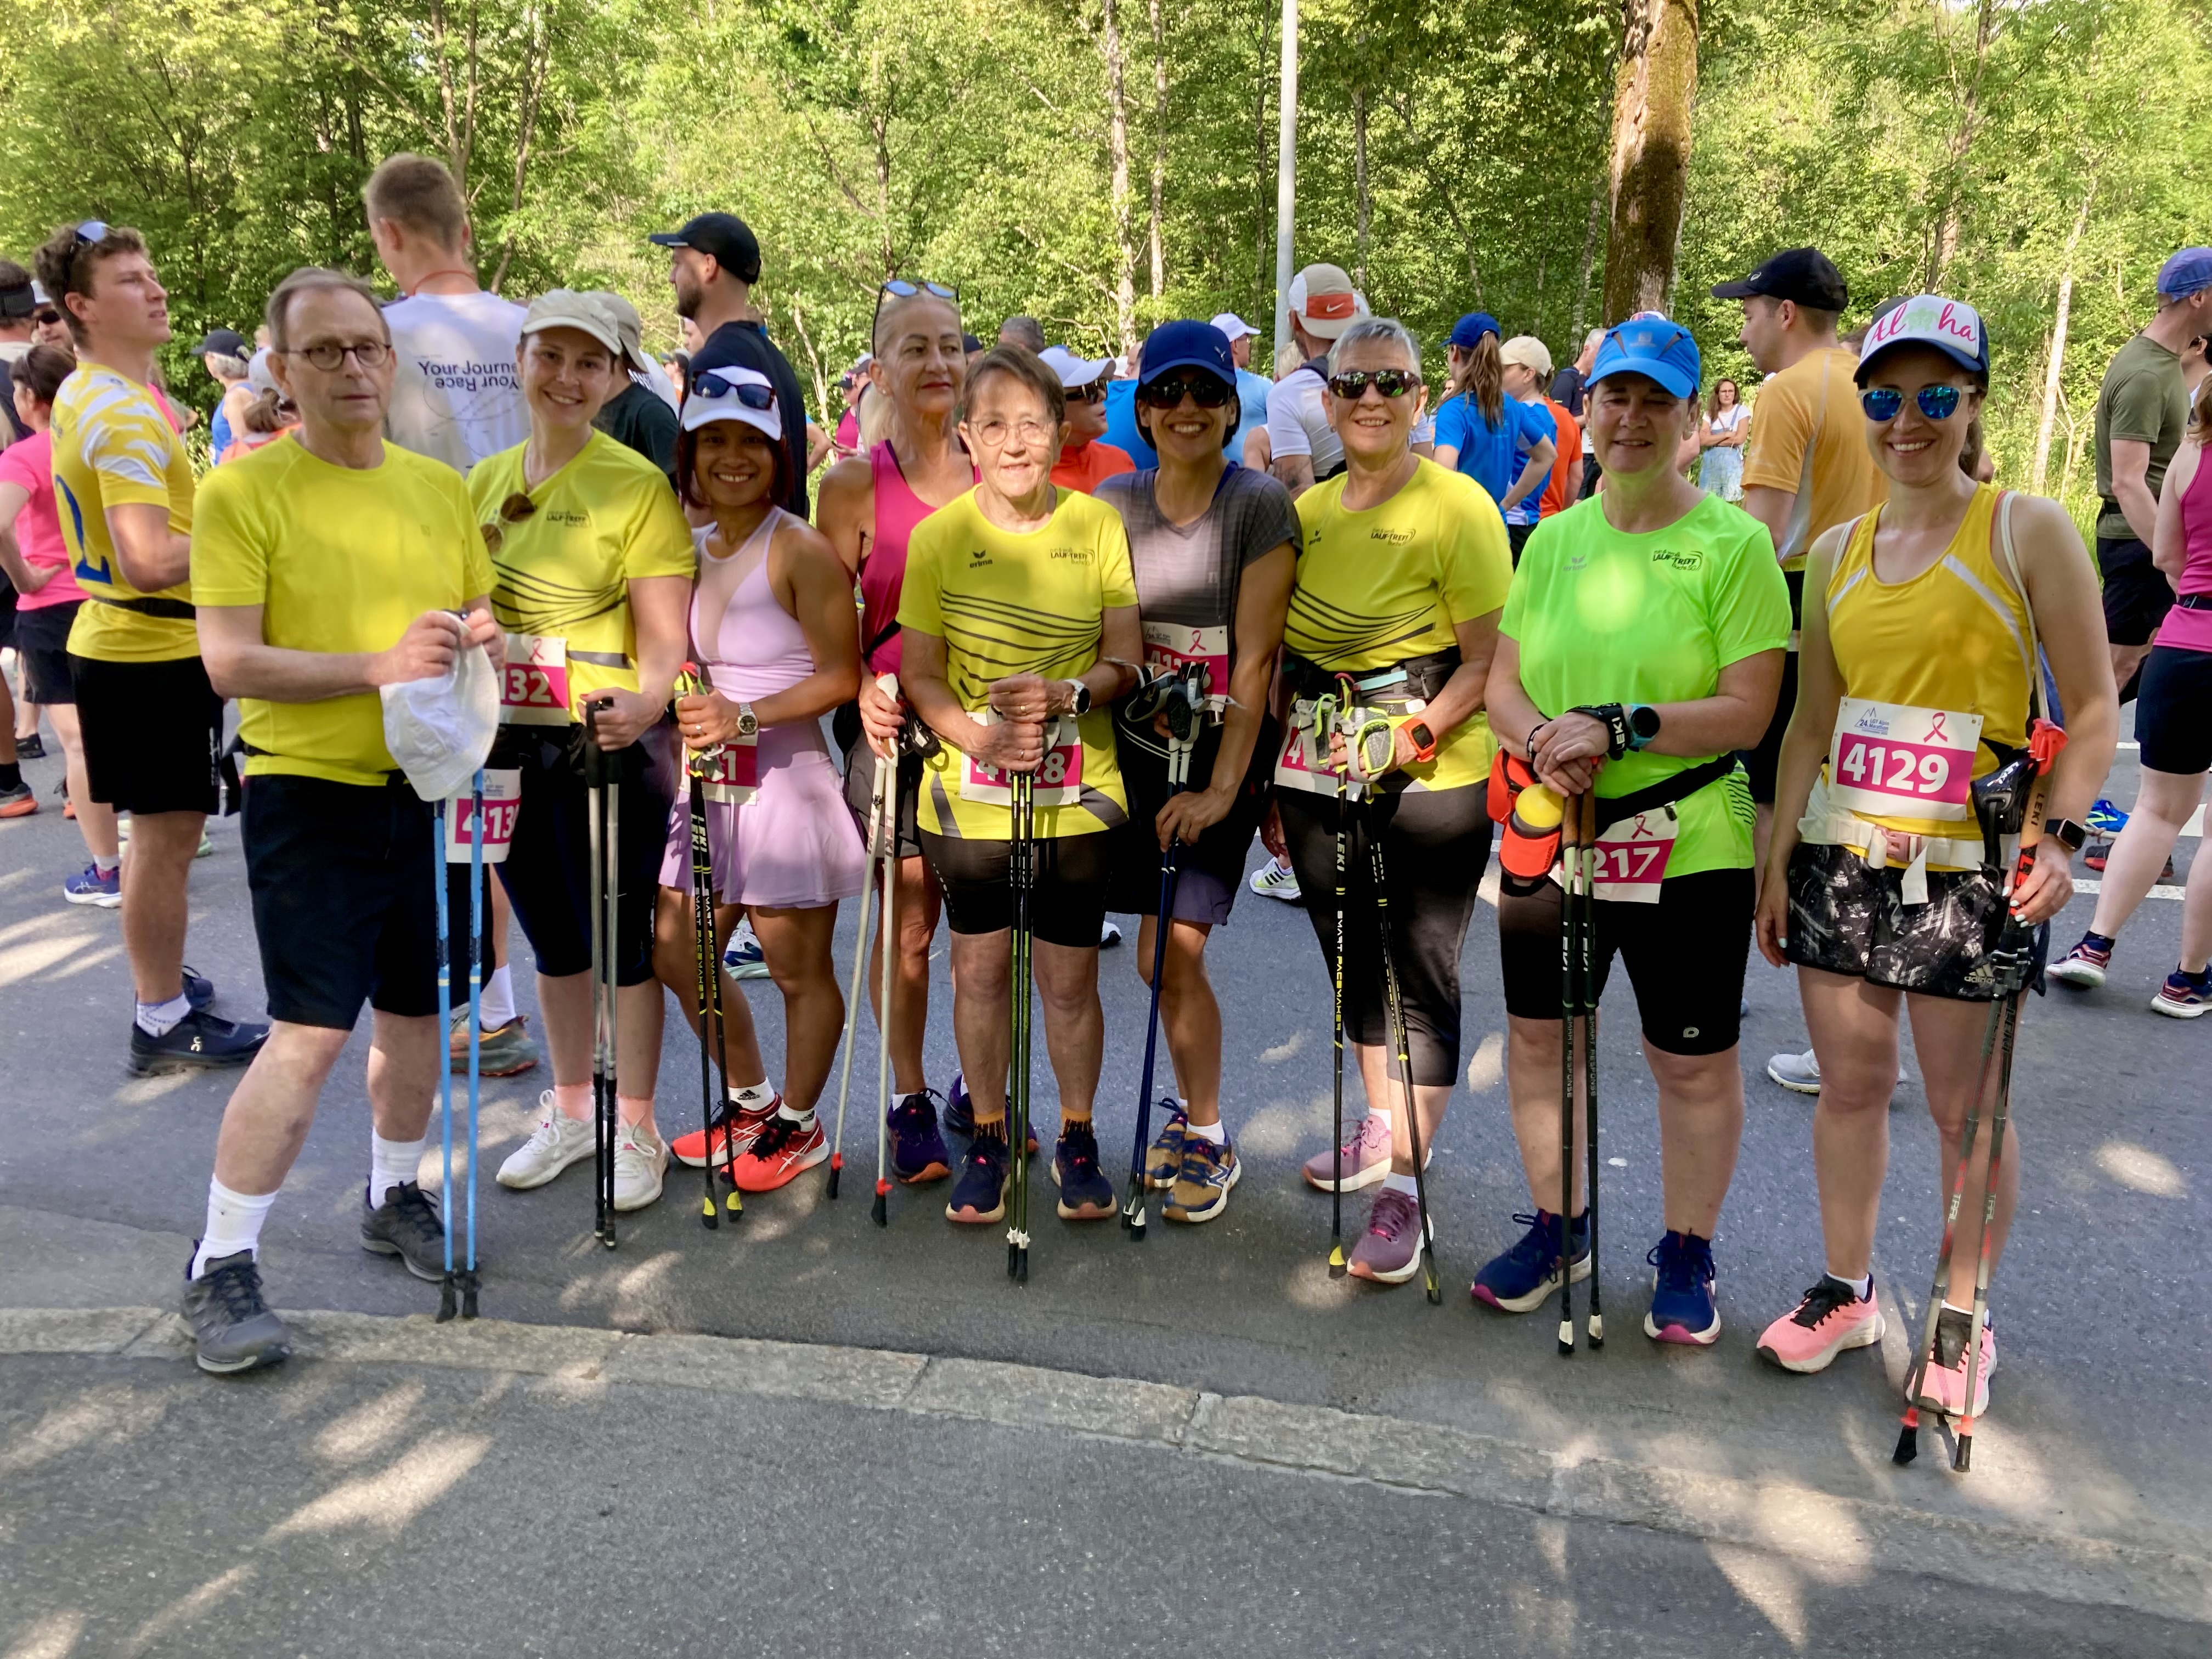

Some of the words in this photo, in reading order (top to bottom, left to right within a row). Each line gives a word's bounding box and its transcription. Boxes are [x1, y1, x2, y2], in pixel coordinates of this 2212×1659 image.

[417, 361, 458, 375] Your
[482, 376, 519, 390] Your
[435, 377, 476, 392] Race
[970, 560, 993, 568] erima
[1842, 743, 1949, 794] 4129
[2031, 793, 2045, 826] LEKI
[698, 816, 708, 853] LEKI
[885, 814, 894, 857] LEKI
[1337, 832, 1346, 871] LEKI
[1575, 846, 1660, 878] 217
[1948, 1193, 1961, 1224] TRAIL
